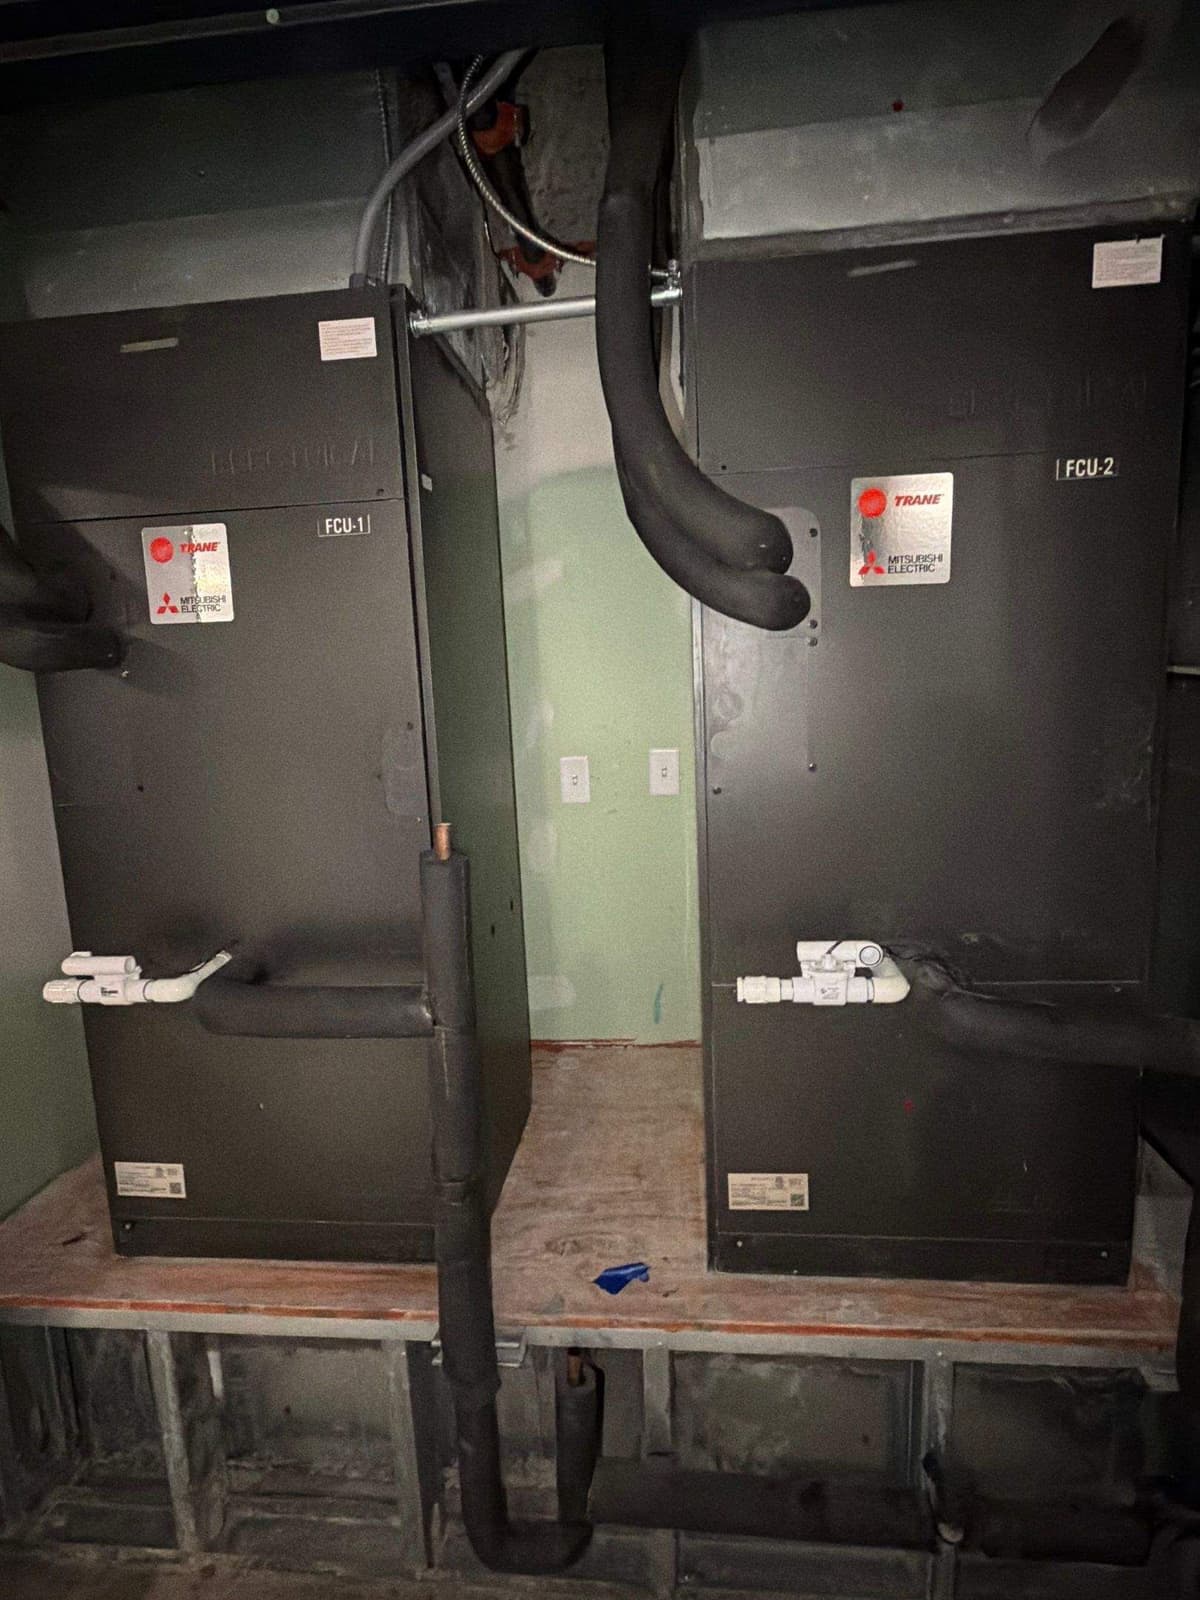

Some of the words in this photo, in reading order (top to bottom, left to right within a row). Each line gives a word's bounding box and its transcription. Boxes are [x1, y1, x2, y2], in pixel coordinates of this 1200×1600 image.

[1066, 457, 1114, 477] FCU-2
[894, 493, 943, 507] TRANE
[325, 516, 364, 534] FCU-1
[180, 541, 219, 553] TRANE
[887, 553, 944, 565] MITSUBISHI
[887, 563, 936, 574] ELECTRIC
[180, 595, 226, 605] MITSUBISHI
[181, 604, 221, 613] ELECTRIC
